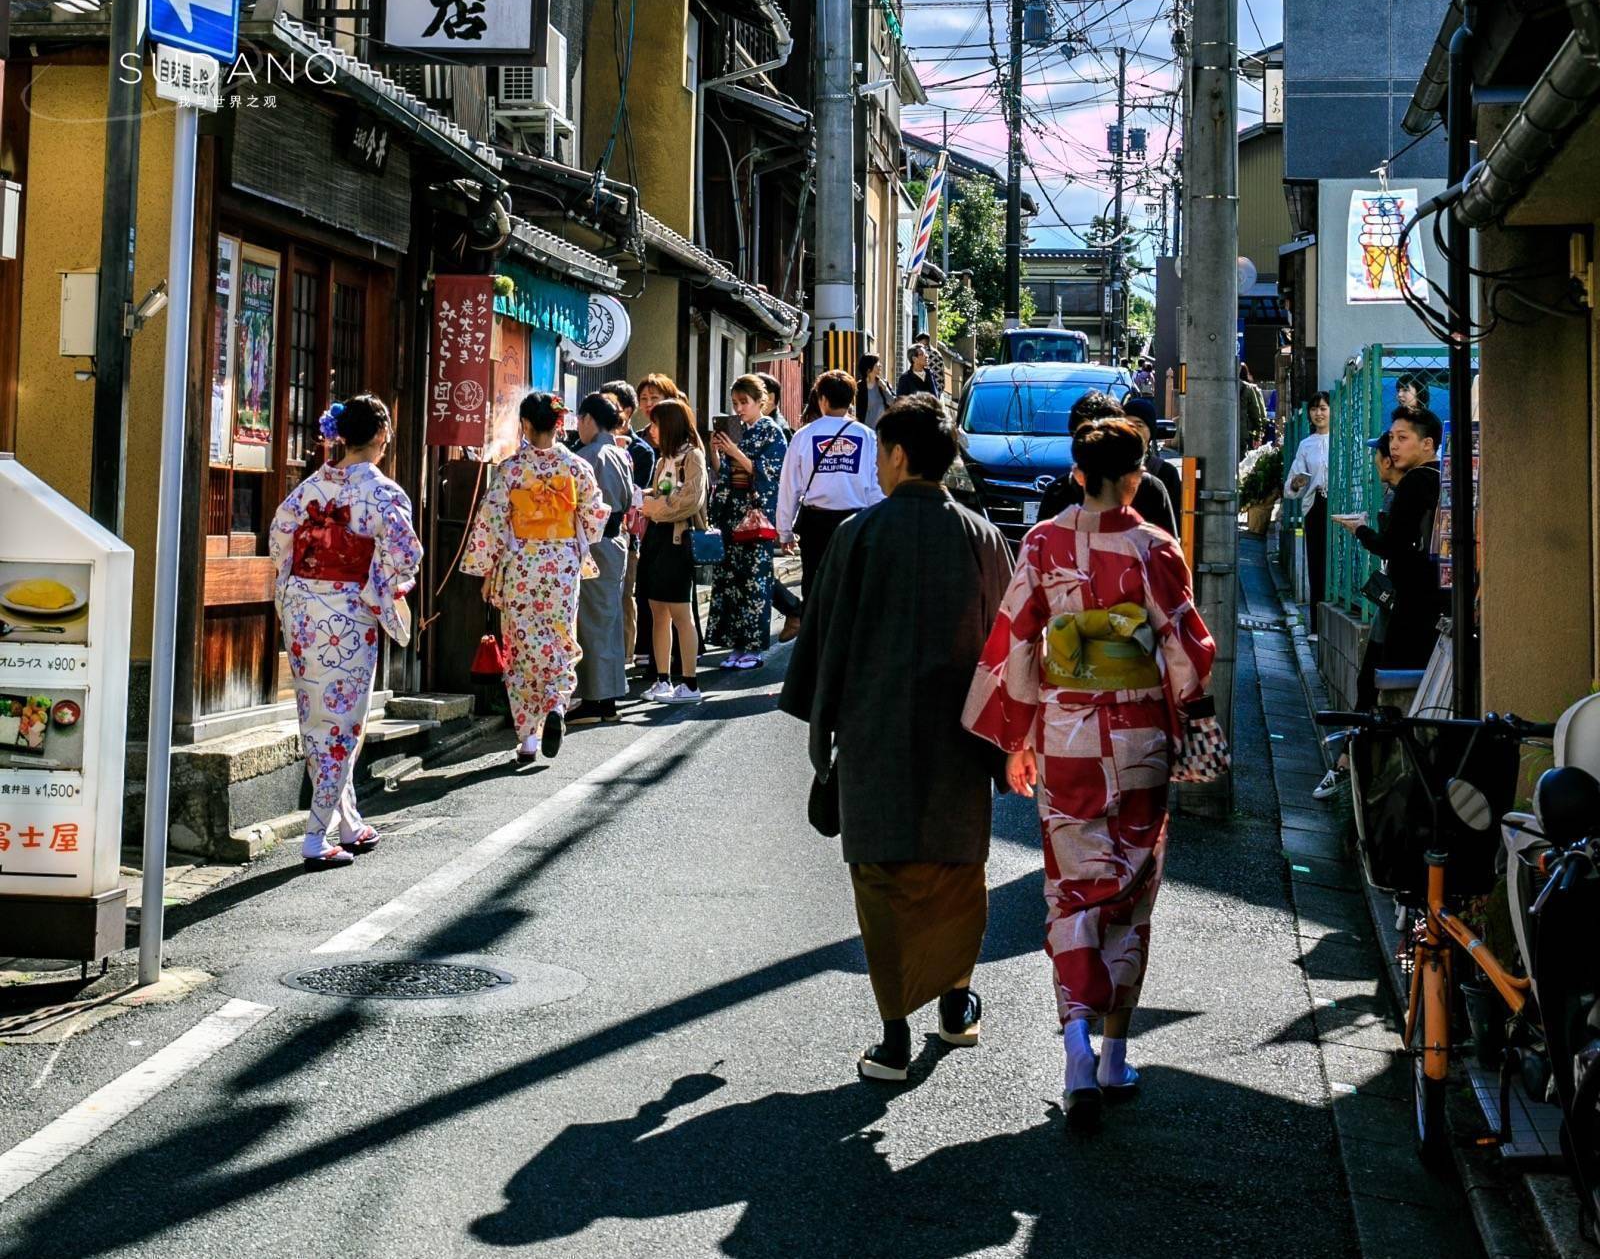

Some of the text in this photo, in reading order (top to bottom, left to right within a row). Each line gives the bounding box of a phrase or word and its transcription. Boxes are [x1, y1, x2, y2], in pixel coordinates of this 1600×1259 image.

[457, 299, 474, 364] 炭火焼き
[433, 300, 457, 422] みたらし団子
[0, 657, 76, 671] オムライス ¥900
[35, 783, 74, 799] ¥1,500
